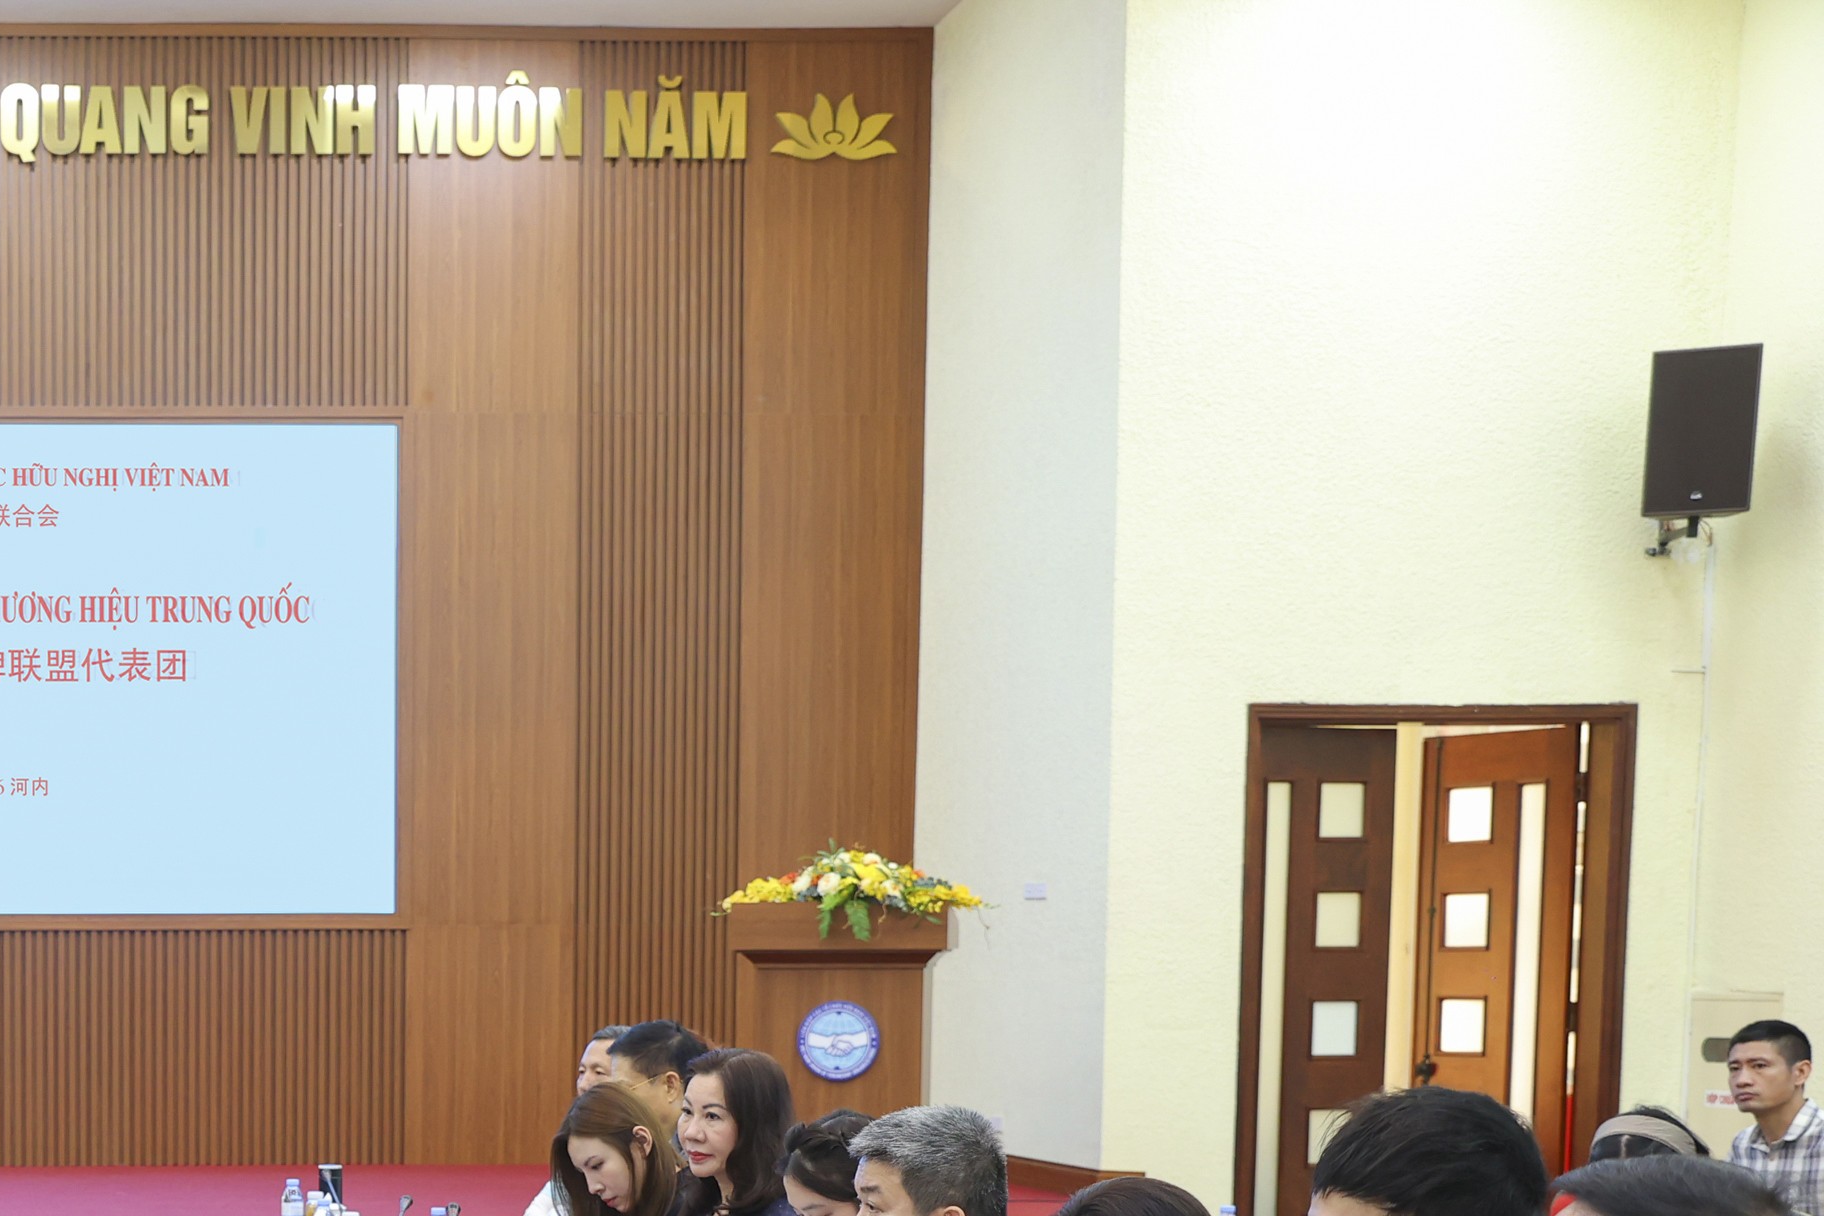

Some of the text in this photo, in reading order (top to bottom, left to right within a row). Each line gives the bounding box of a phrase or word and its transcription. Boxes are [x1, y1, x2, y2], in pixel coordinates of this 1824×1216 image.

[229, 83, 377, 156] VINH
[396, 69, 584, 159] MUÔN
[602, 74, 748, 160] NĂM
[12, 462, 58, 487] HỮU
[63, 467, 119, 492] NGHỊ
[124, 462, 175, 492] VIỆT
[180, 467, 230, 487] NAM
[79, 586, 140, 631] HIỆU
[145, 595, 233, 624] TRUNG
[238, 581, 310, 630] QUỐC
[10, 777, 49, 797] 河内
